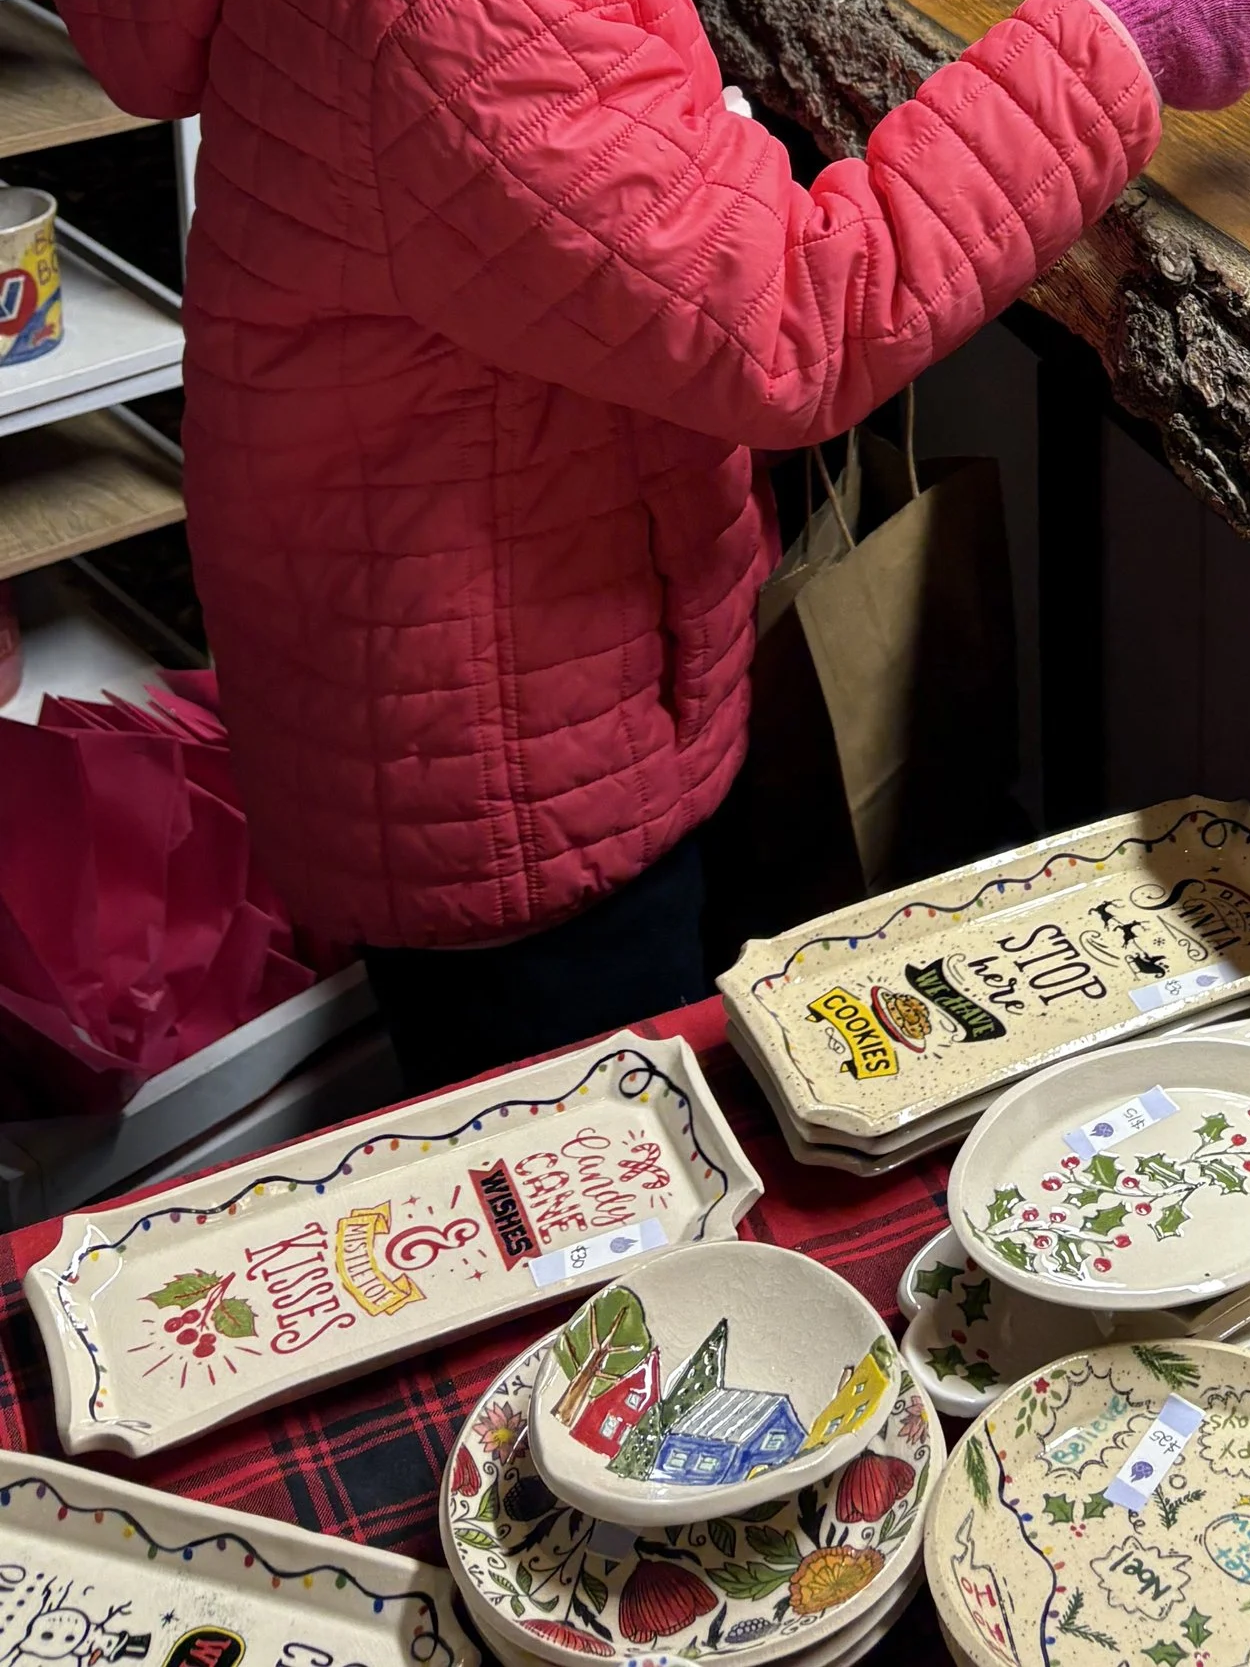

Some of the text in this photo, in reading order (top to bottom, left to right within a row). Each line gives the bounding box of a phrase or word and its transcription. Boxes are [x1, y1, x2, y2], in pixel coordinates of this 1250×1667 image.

[1130, 878, 1241, 952] SANTA
[967, 955, 1026, 1016] here
[997, 924, 1108, 1007] STOP
[823, 994, 891, 1074] COOKIES
[480, 1169, 534, 1257] WISHES
[514, 1152, 589, 1245] CANE
[560, 1127, 637, 1228] Candy
[343, 1222, 399, 1307] MISTLETOE
[385, 1217, 480, 1271] &
[570, 1245, 589, 1269] $30
[245, 1221, 357, 1355] KISSES
[1051, 1394, 1128, 1465] Believe
[1150, 1430, 1181, 1455] $25
[1109, 1551, 1171, 1601] Noel
